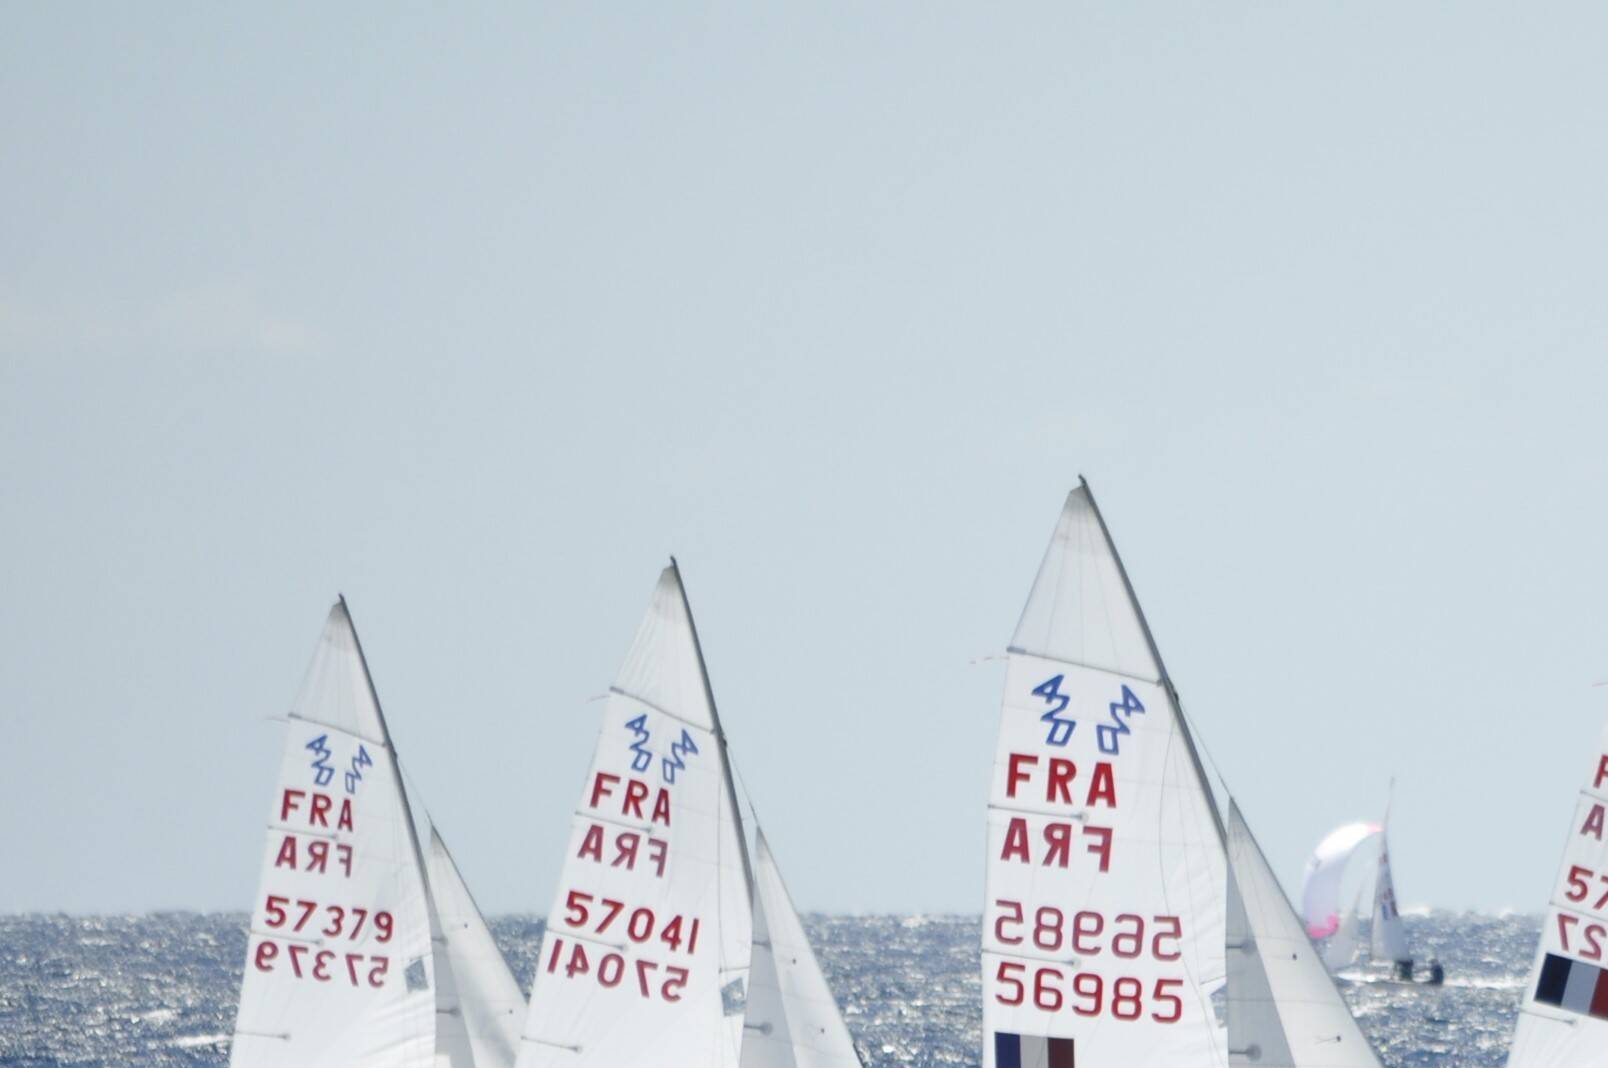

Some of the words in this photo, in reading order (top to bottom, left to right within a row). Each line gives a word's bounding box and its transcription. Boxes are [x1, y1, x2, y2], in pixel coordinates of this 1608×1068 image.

[589, 771, 672, 827] FRA
[1006, 752, 1118, 809] FRA
[280, 788, 354, 833] FRA
[264, 895, 395, 944] 57379
[564, 888, 701, 956] 57041
[995, 960, 1185, 1024] 56985
